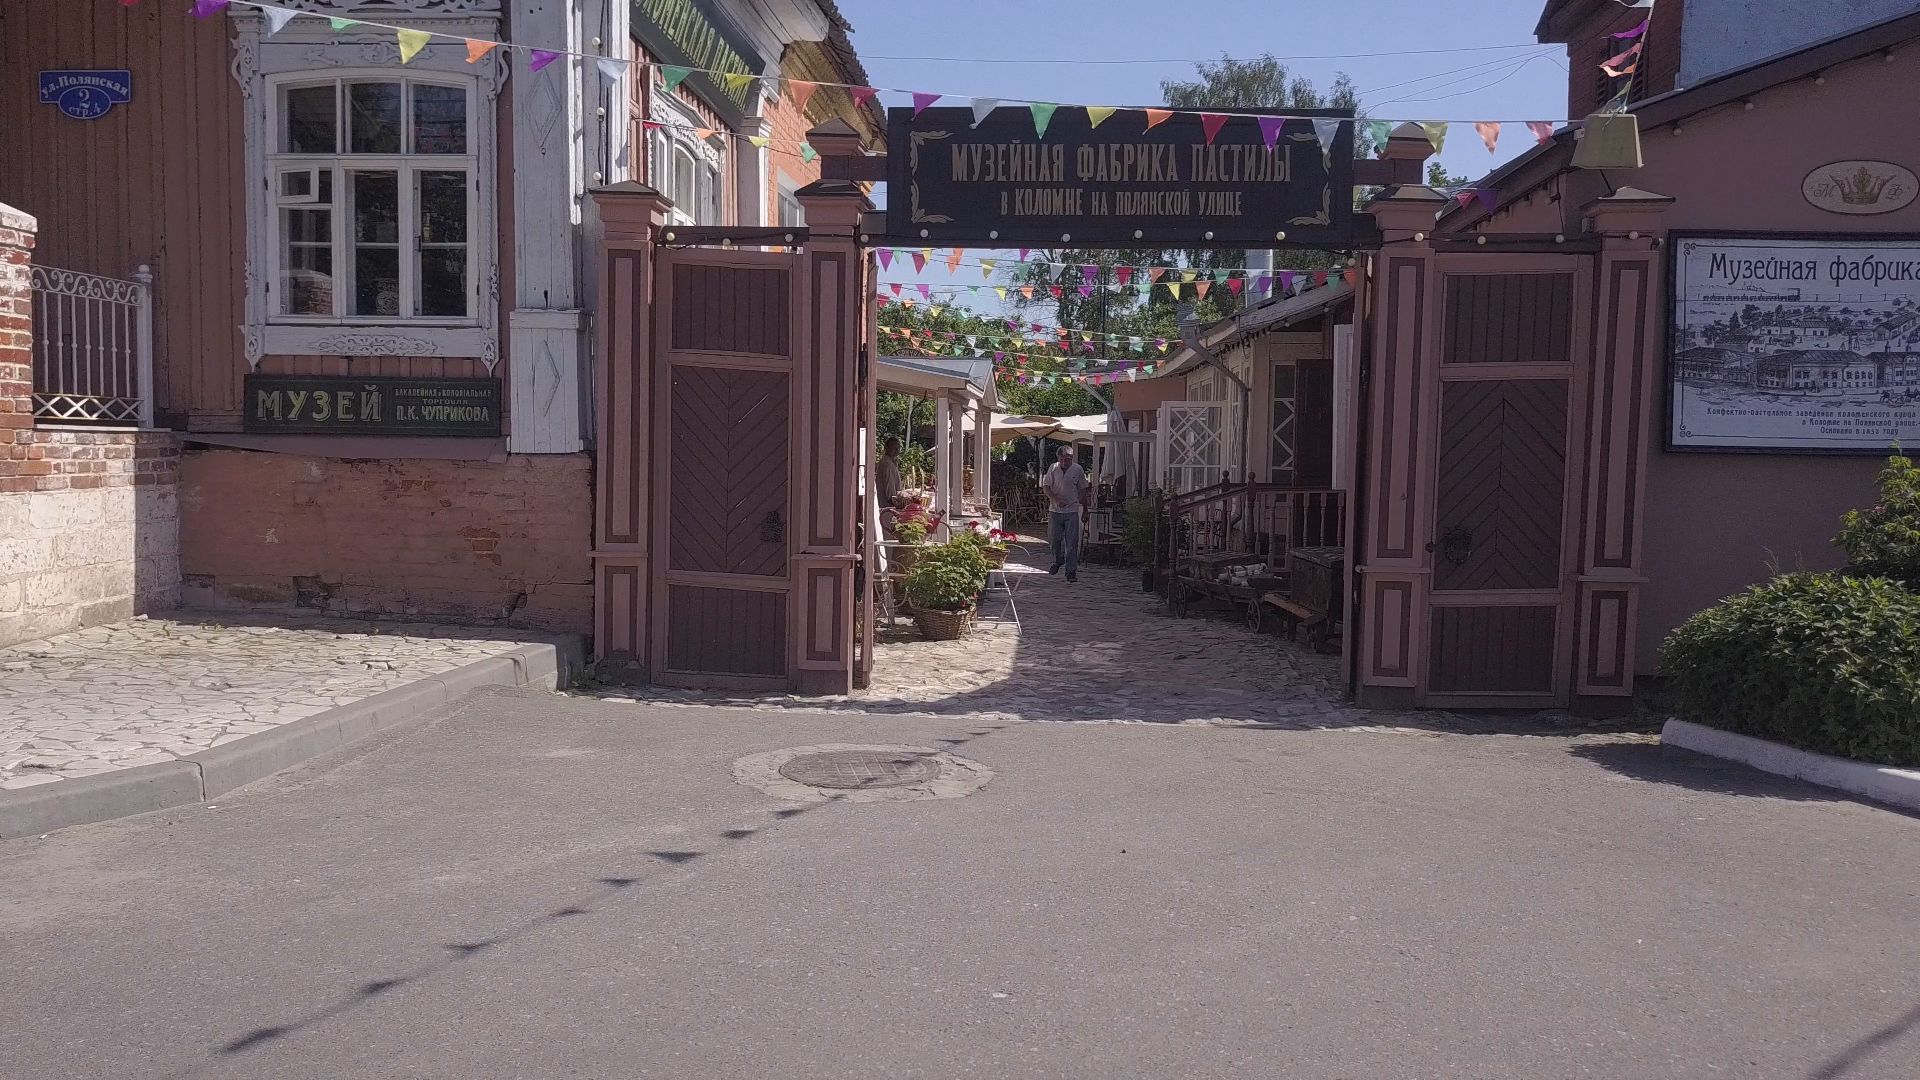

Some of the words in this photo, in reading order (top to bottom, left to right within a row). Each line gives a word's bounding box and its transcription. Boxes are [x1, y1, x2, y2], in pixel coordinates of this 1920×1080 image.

[79, 89, 91, 108] 2
[951, 139, 1064, 182] МУЗЕЙНАЯ
[1076, 143, 1179, 182] ФАБРИКА
[1190, 143, 1291, 182] ПАСТИЛЫ
[1001, 191, 1008, 216] В
[1015, 188, 1083, 216] КОЛОМНЕ
[1091, 191, 1109, 216] НА
[1115, 188, 1190, 216] ПОЛЯНСКОЙ
[1198, 191, 1242, 217] УЛИЦЕ
[1708, 252, 1818, 286] Музейная
[256, 384, 382, 422] МУЗЕЙ
[421, 405, 489, 422] ЧУПРИКОВА
